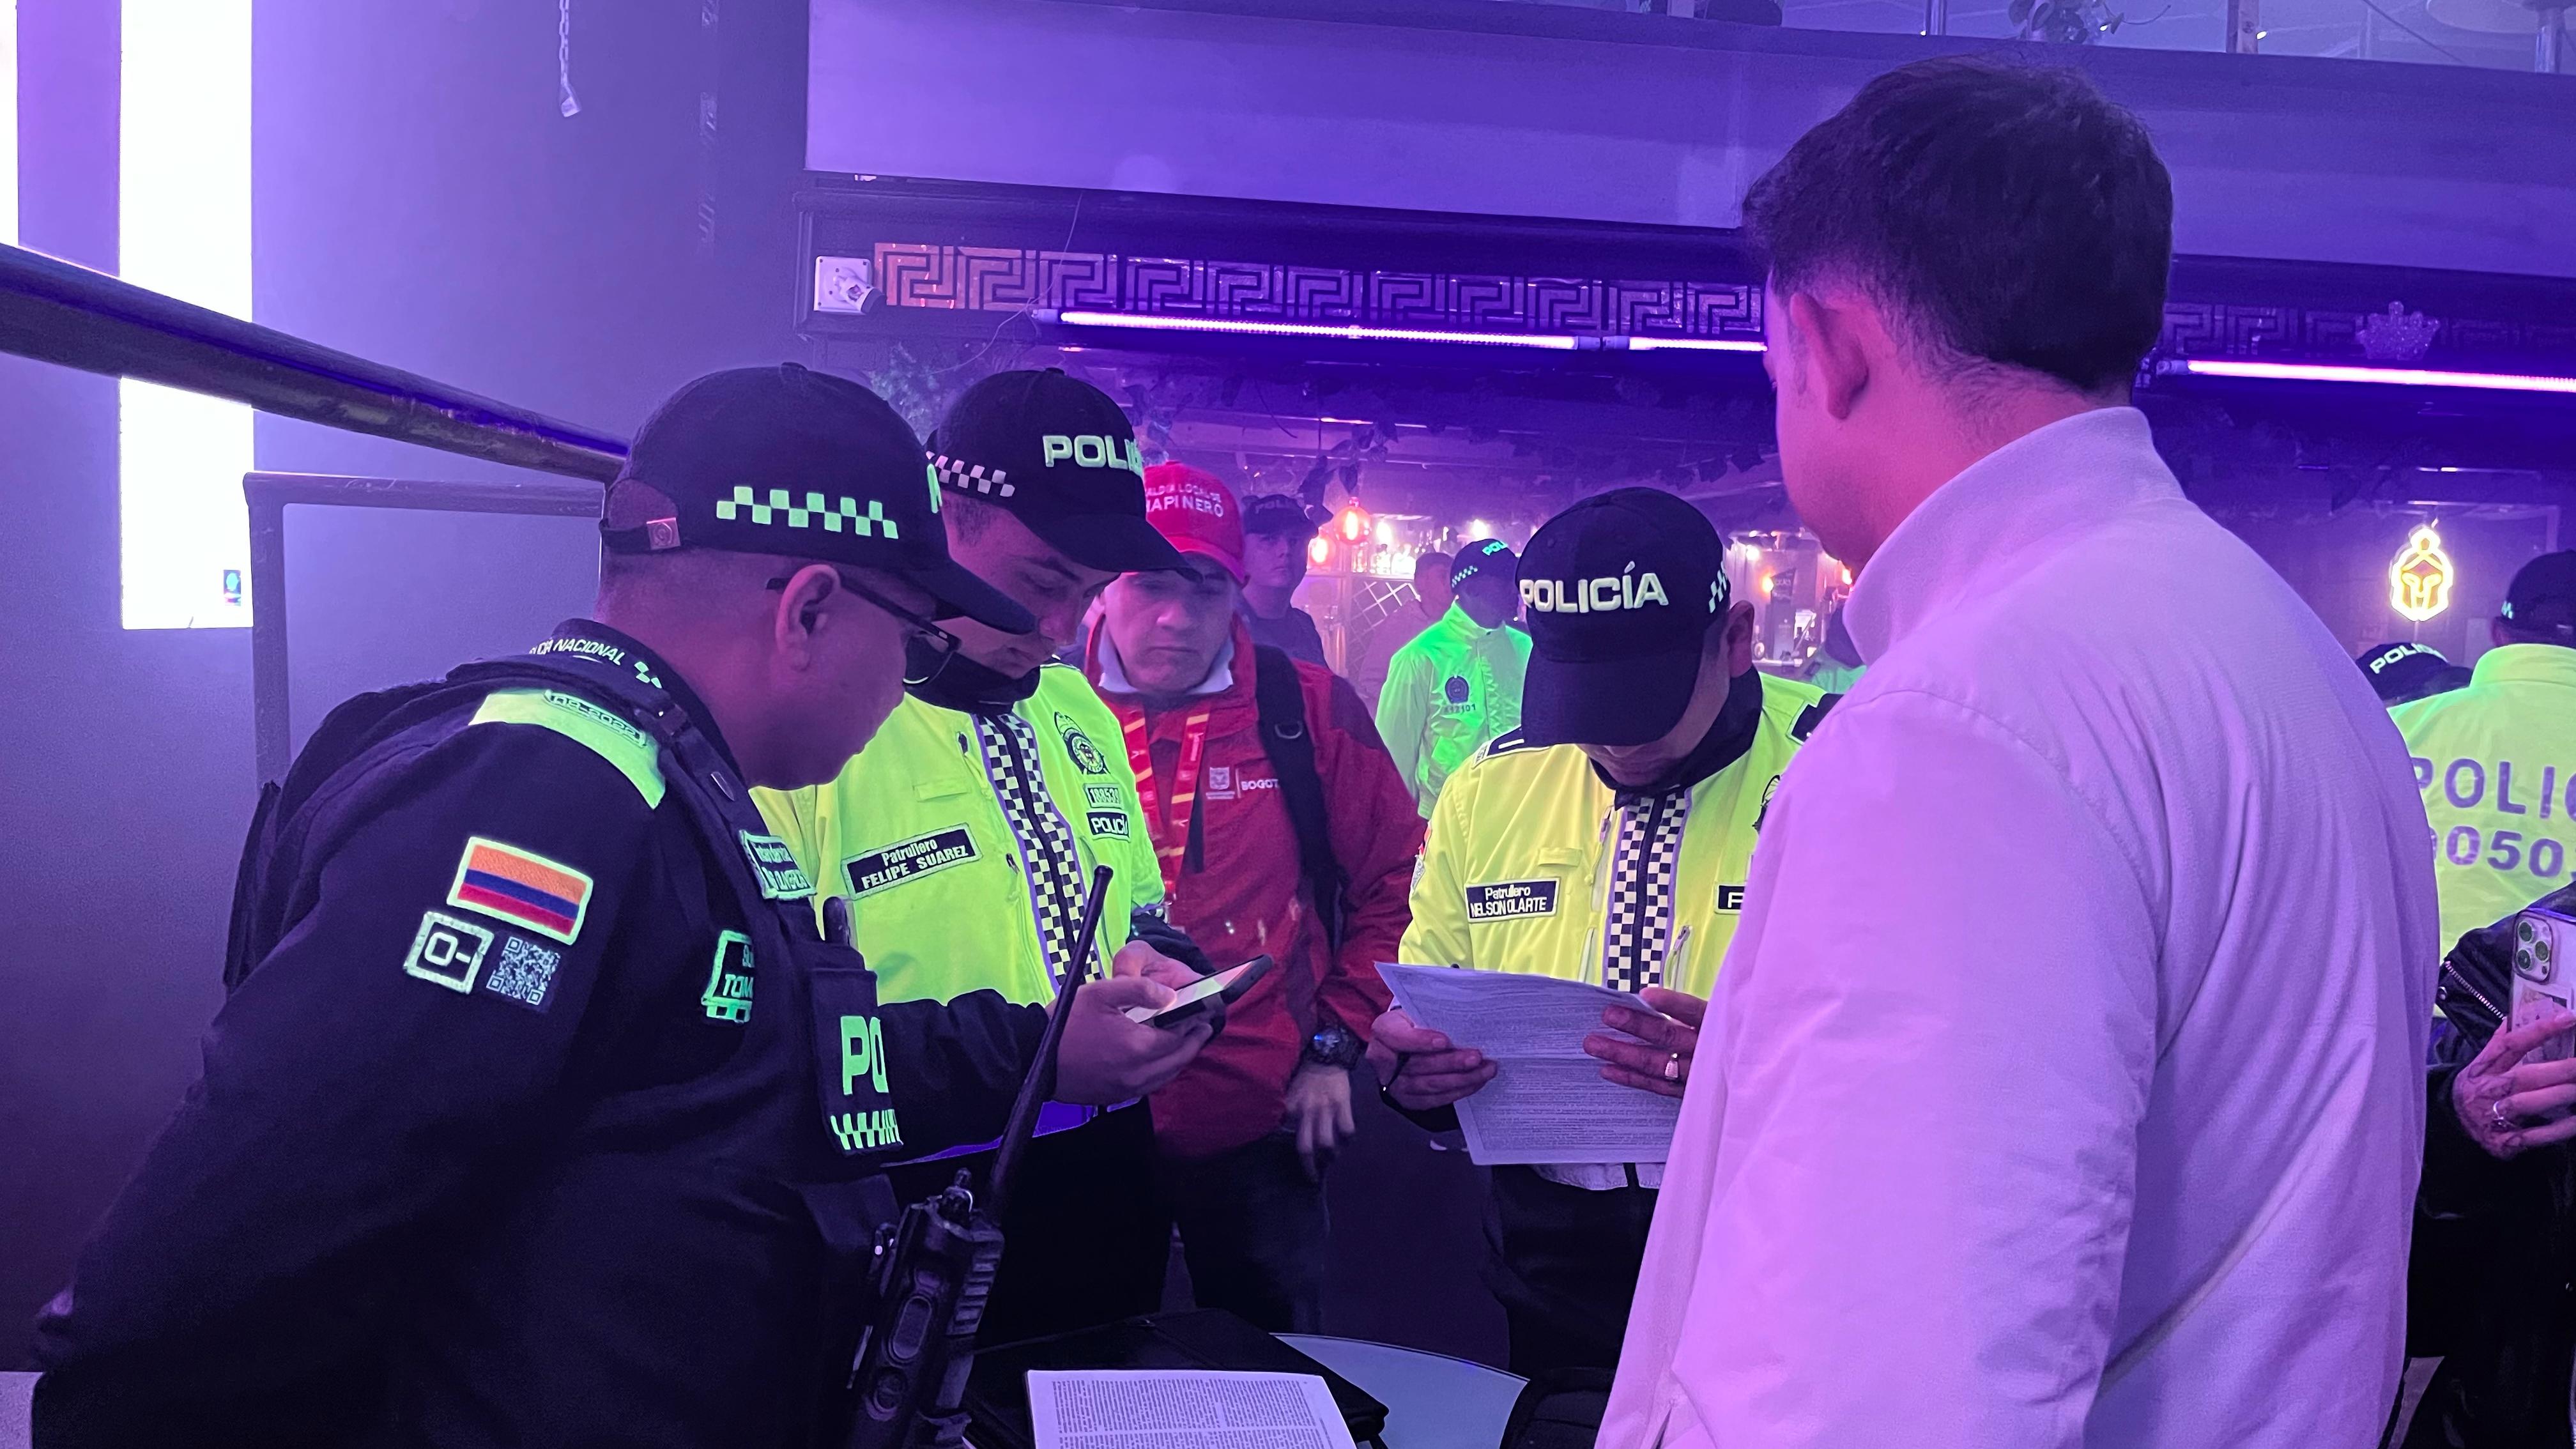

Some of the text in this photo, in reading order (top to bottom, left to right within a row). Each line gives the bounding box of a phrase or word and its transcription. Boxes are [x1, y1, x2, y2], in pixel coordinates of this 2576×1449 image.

[1519, 560, 1669, 613] POLICÍA
[553, 638, 625, 666] NACIONAL
[861, 845, 969, 890] FELIPE SUAREZ
[882, 839, 938, 866] Patrullero
[2429, 825, 2576, 881] 050
[1470, 896, 1547, 918] NELSON OLARTE
